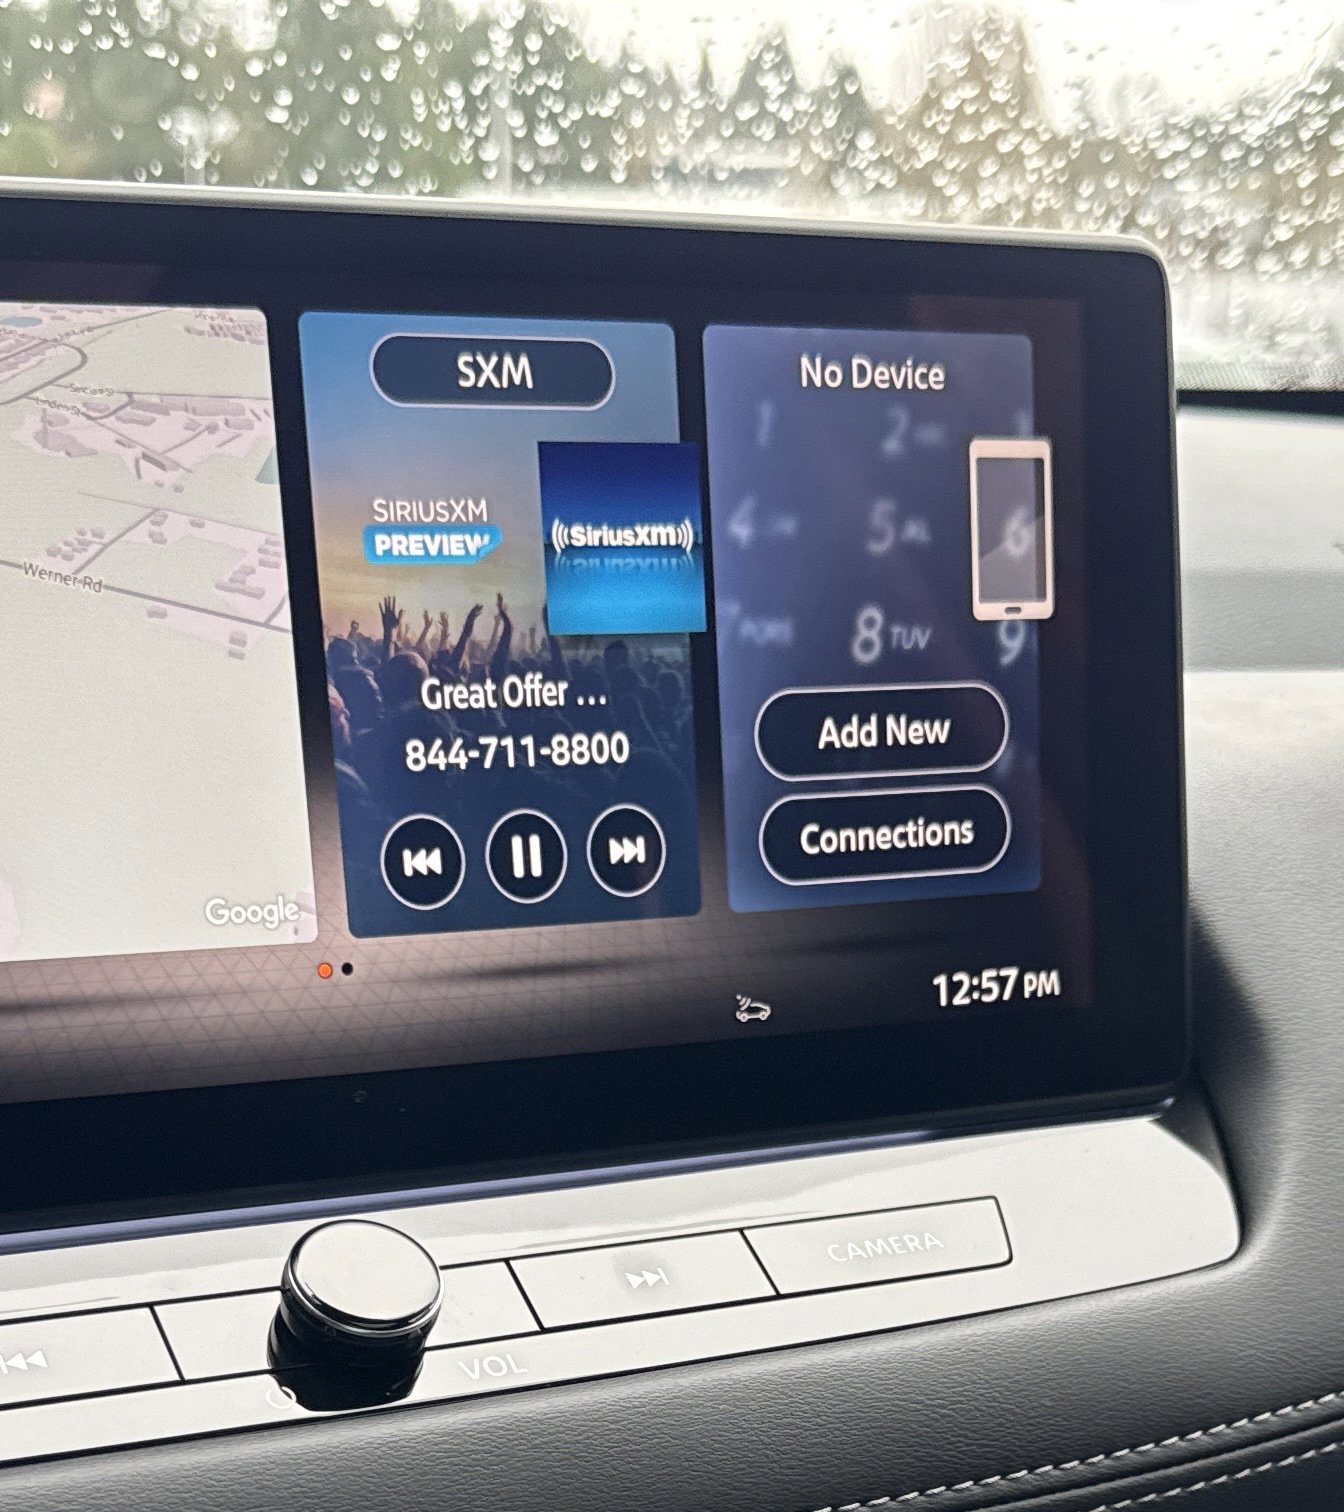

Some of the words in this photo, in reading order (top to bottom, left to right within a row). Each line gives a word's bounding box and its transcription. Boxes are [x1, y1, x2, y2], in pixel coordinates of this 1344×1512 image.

[457, 352, 534, 389] SXM
[800, 353, 843, 389] No
[852, 354, 945, 390] Device
[373, 498, 488, 522] SIRIUSXM
[375, 533, 490, 557] PREVIEW
[23, 562, 78, 588] Werner
[82, 576, 103, 593] Rd
[851, 604, 885, 664] 8
[421, 677, 496, 710] Great
[503, 673, 568, 708] Offer
[818, 714, 878, 749] Add
[886, 714, 951, 746] New
[405, 732, 630, 771] 844-711-8800
[800, 818, 975, 855] Connections
[204, 895, 300, 929] Google
[933, 967, 1018, 1006] 12:57
[1023, 970, 1061, 998] PM
[827, 1231, 945, 1264] CAMERA
[460, 1352, 528, 1383] VOL
